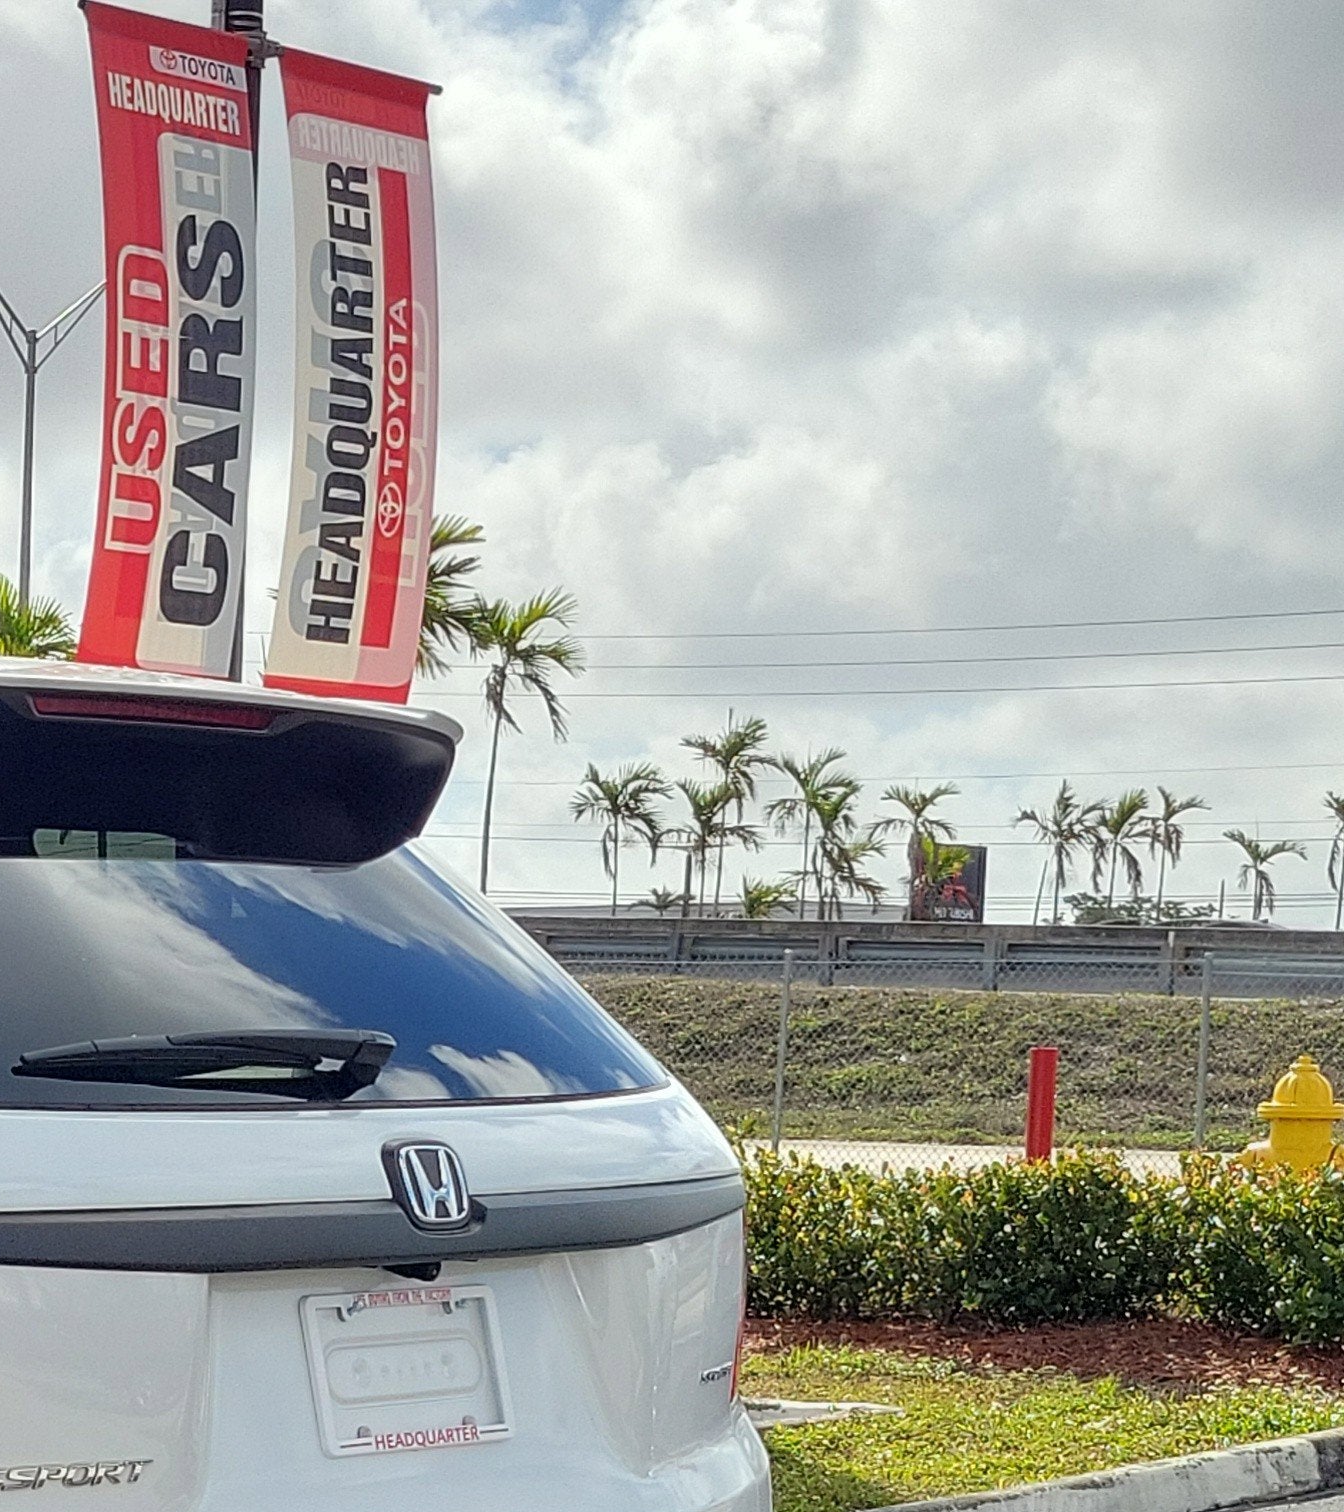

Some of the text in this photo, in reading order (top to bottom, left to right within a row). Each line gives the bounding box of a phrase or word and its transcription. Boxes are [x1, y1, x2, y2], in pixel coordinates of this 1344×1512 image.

[108, 72, 240, 136] HEADQUARTER
[179, 53, 236, 86] TOYOTA
[104, 245, 169, 553] USED
[159, 215, 244, 627] CARS
[306, 161, 374, 644] HEADQUARTER
[383, 298, 408, 476] TOYOTA
[374, 1425, 480, 1451] HEADQUARTER
